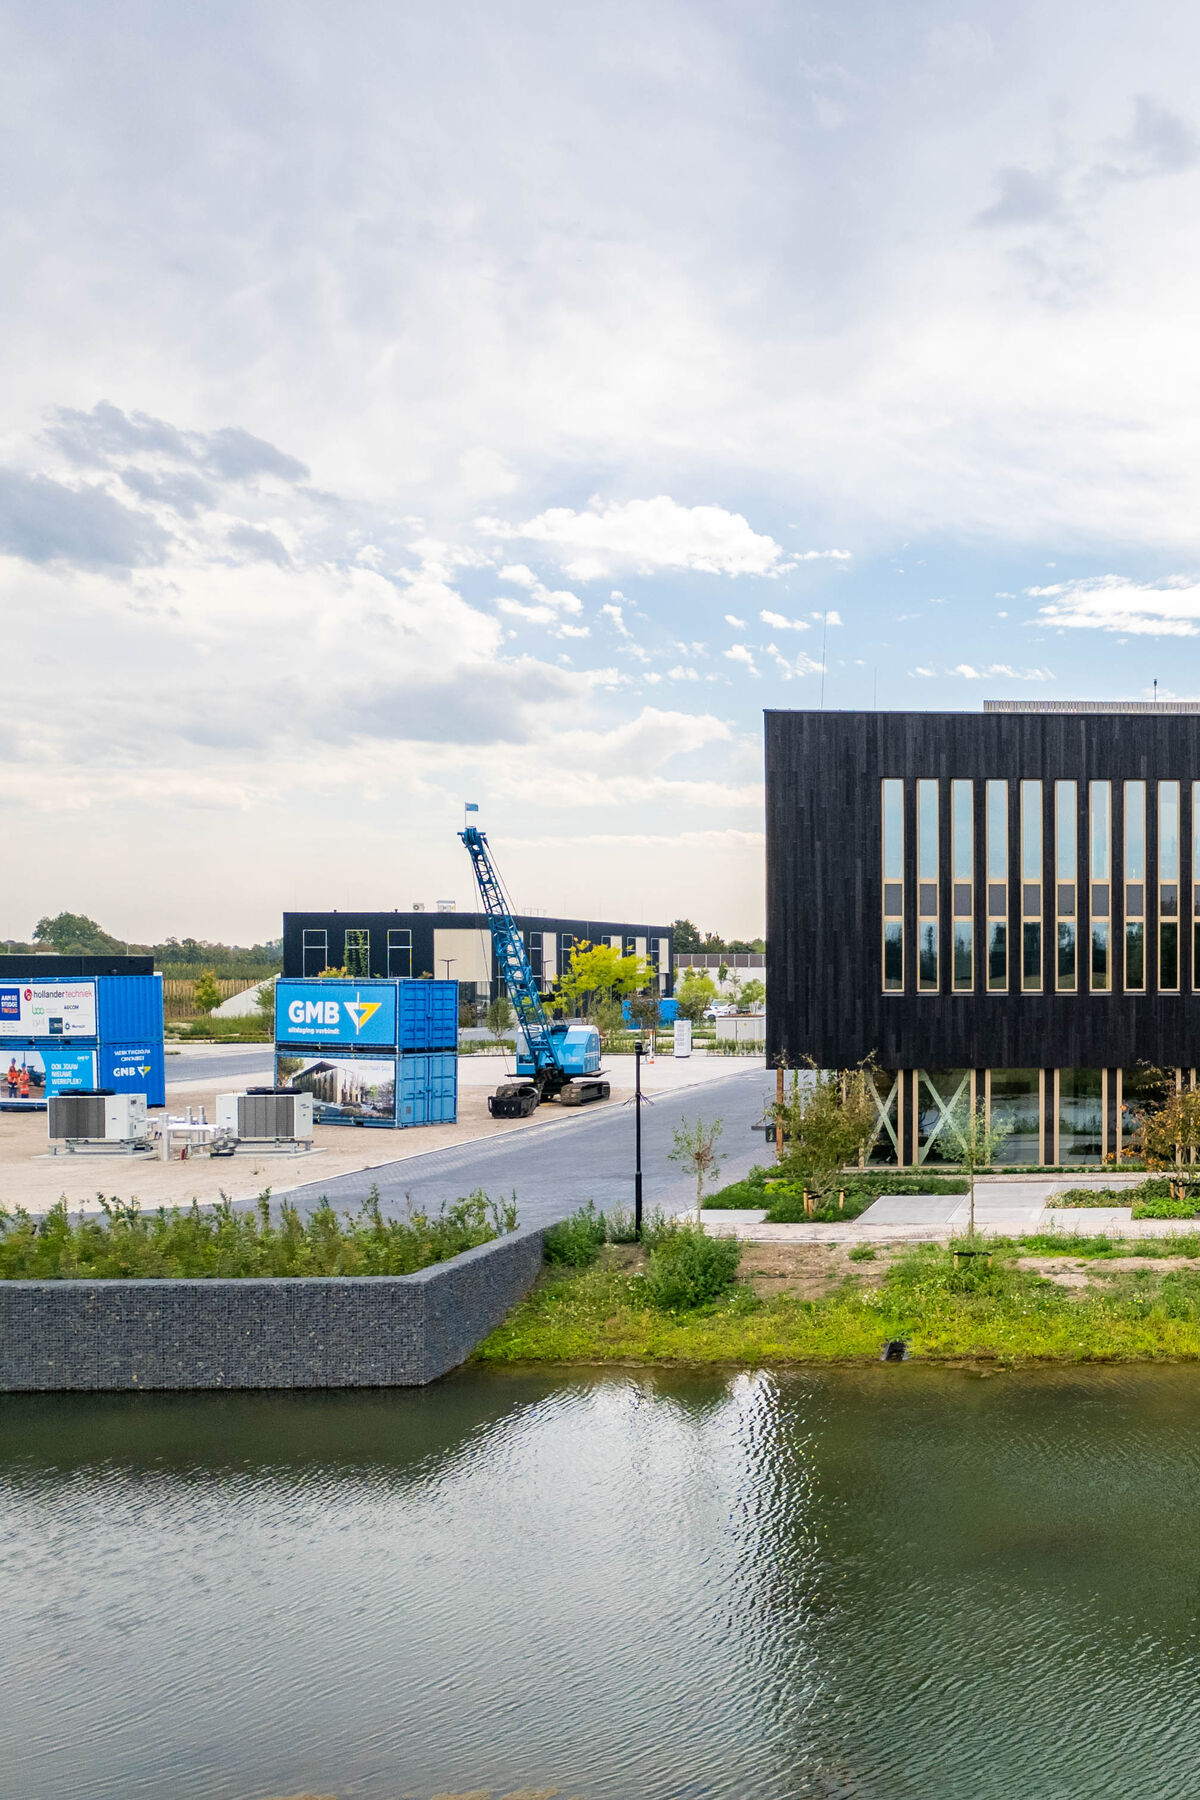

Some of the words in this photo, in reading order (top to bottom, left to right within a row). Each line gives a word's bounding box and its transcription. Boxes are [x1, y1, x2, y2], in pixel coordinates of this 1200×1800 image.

[288, 1000, 340, 1025] GMB
[288, 1027, 315, 1035] uitdaging
[315, 1027, 340, 1035] verbindt
